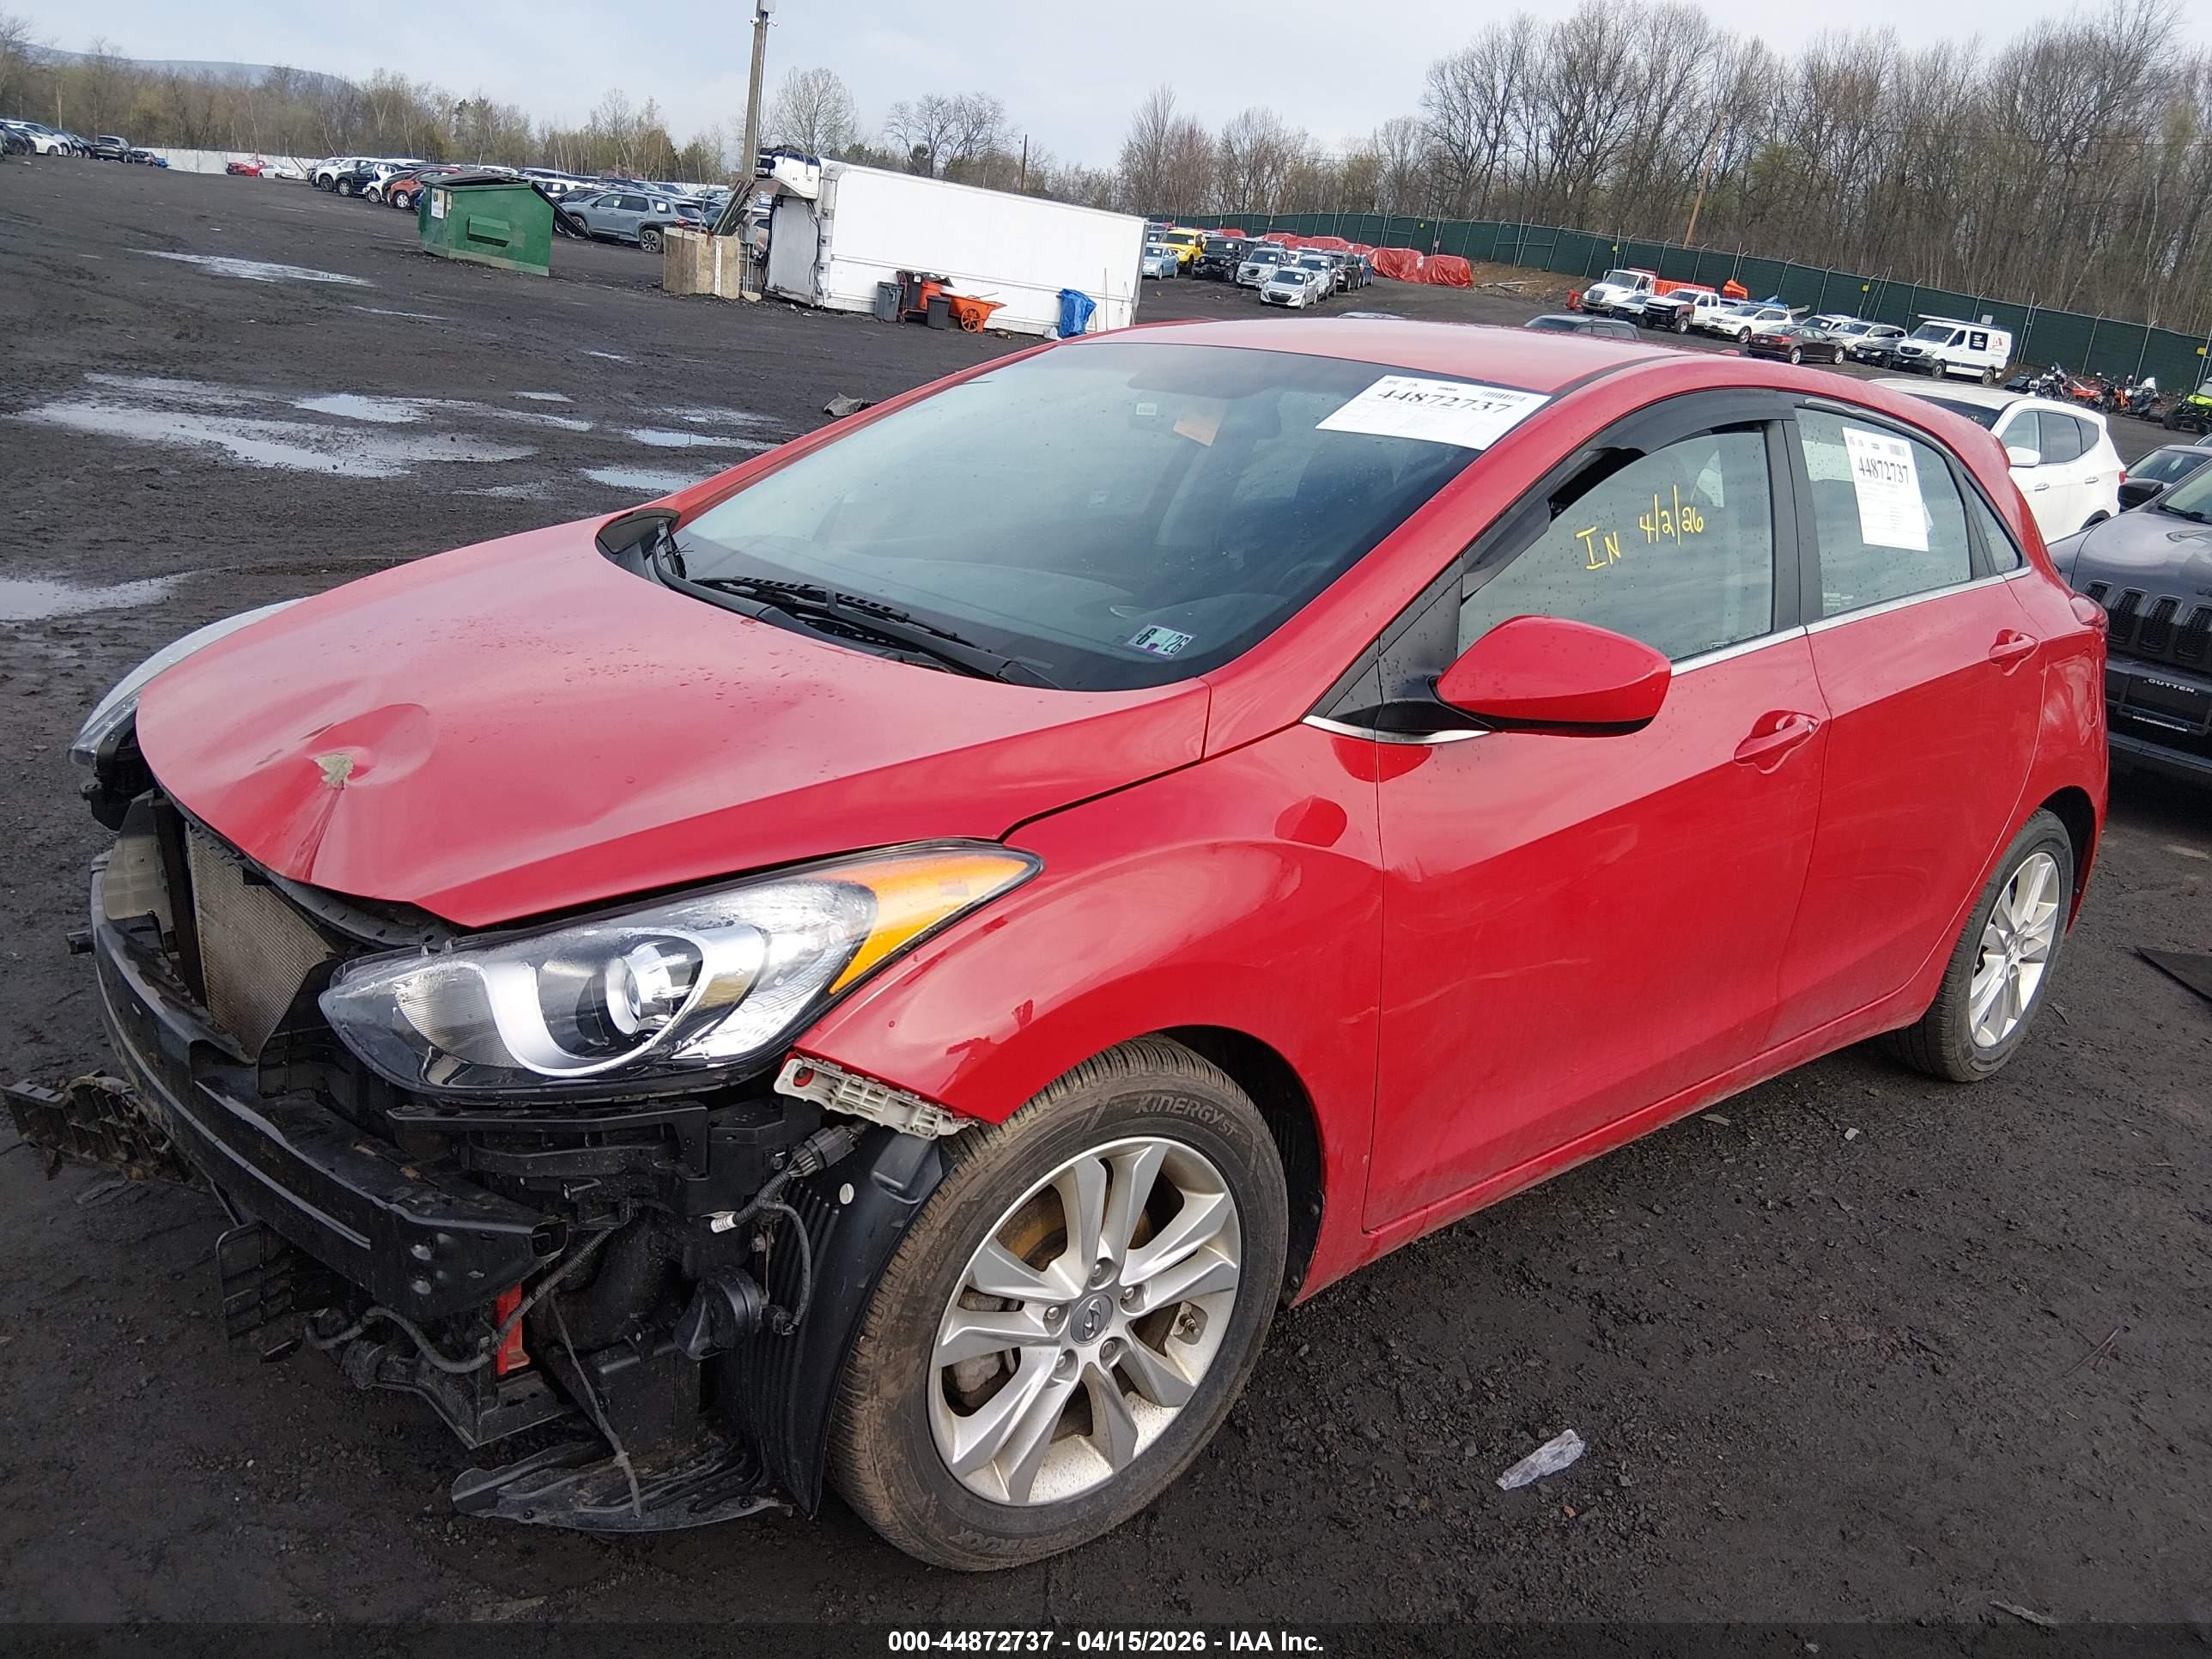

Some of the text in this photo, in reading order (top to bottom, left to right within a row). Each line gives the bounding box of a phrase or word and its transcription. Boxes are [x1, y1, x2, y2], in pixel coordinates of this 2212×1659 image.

[1376, 389, 1513, 414] 44872737
[1858, 455, 1910, 484] 44872737
[1576, 484, 1705, 570] IN 4/2/26
[2148, 678, 2195, 693] OUTTEN
[1134, 1093, 1225, 1125] KINERGY
